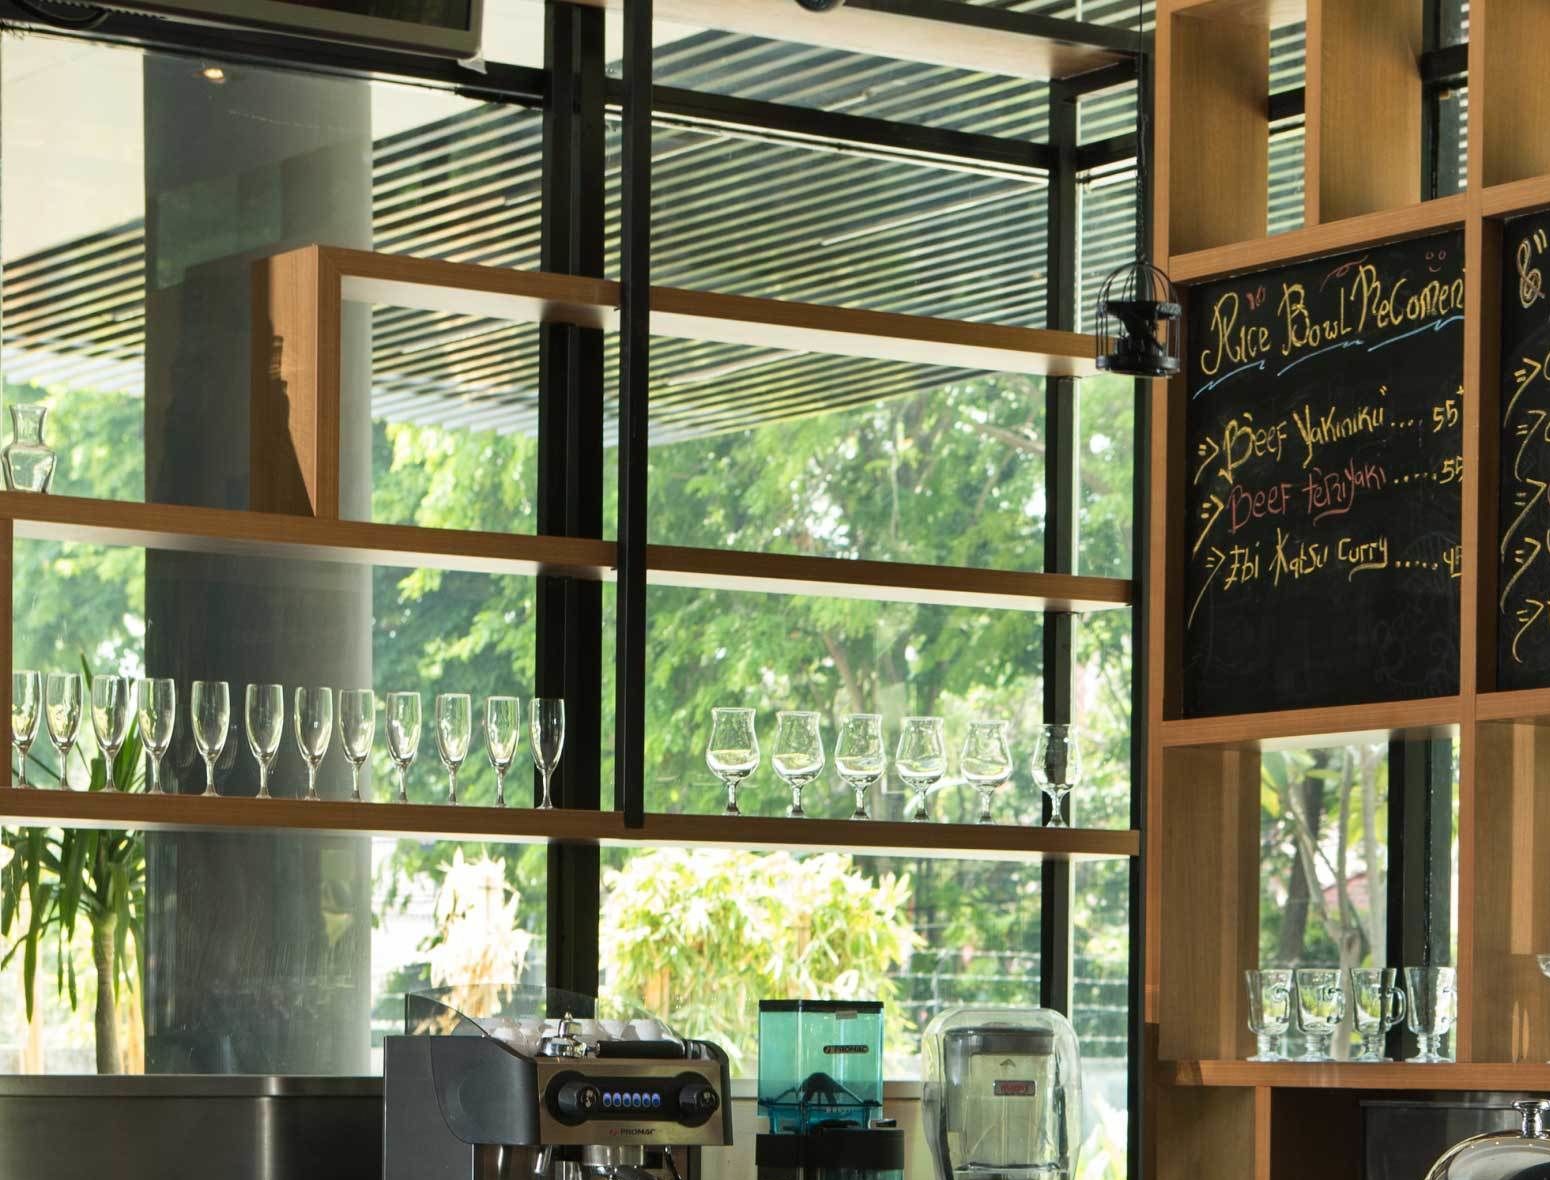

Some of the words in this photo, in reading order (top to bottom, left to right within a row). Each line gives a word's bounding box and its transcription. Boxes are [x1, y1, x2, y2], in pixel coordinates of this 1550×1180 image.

[1201, 291, 1271, 376] Rice
[1277, 283, 1352, 357] Bowl
[1224, 541, 1260, 591] Ebi
[620, 1127, 657, 1137] PROMAC
